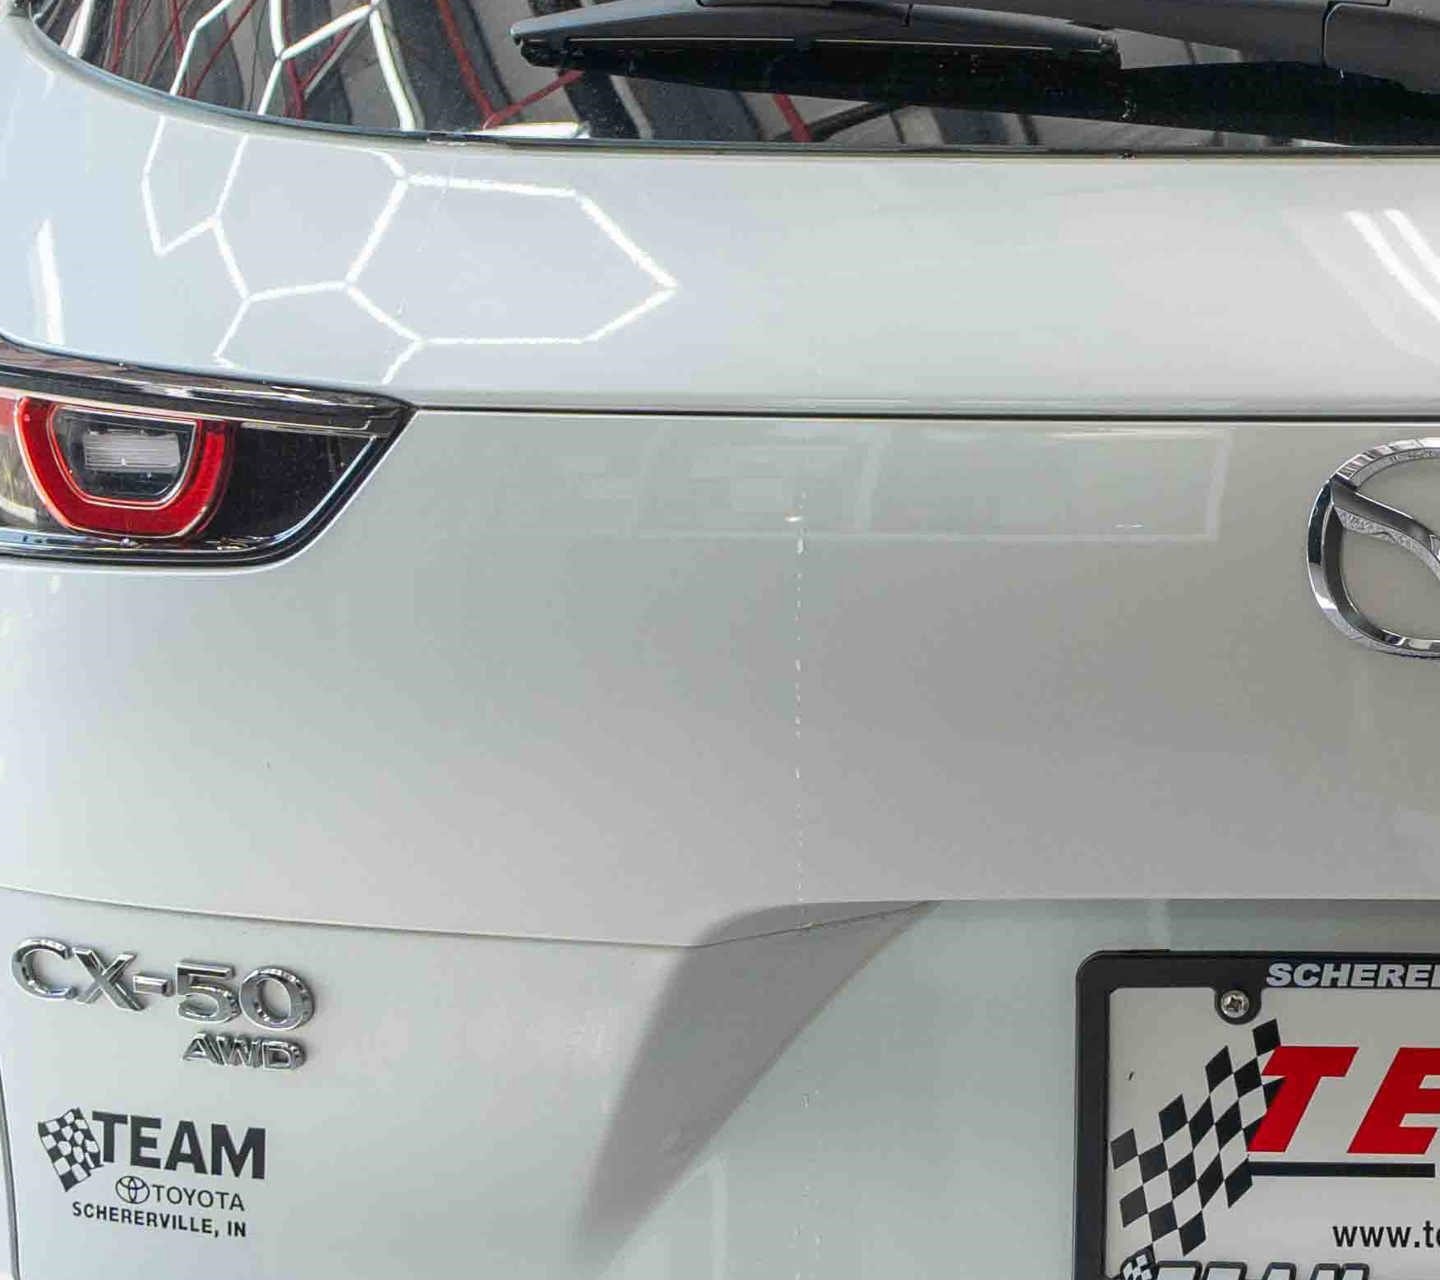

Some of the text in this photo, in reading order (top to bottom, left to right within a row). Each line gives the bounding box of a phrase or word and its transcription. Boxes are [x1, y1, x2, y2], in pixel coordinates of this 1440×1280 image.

[11, 936, 316, 1032] CX-50
[181, 1030, 308, 1071] AWD
[91, 1109, 267, 1180] TEAM
[152, 1183, 246, 1212] TOYOTA
[72, 1200, 247, 1238] SCHERERVILLE, IN
